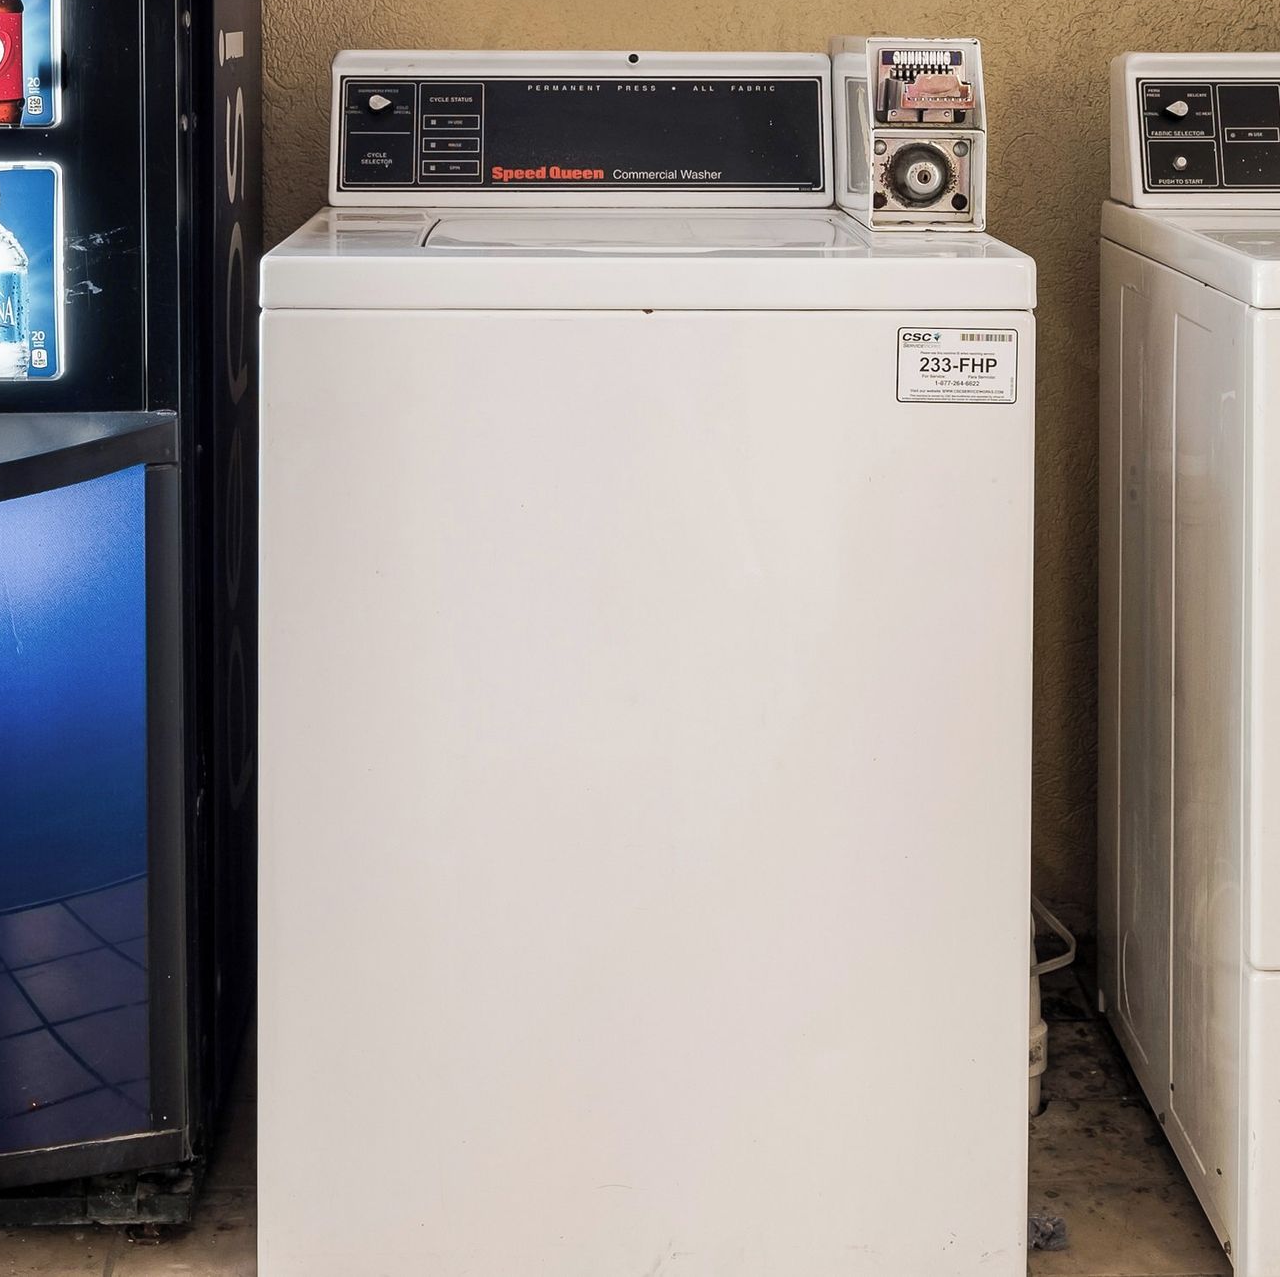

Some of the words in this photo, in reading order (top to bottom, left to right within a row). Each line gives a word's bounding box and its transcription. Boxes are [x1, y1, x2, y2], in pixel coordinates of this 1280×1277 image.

[27, 77, 40, 87] 20
[491, 165, 546, 181] Speed
[549, 165, 604, 179] Queen
[613, 169, 678, 180] Commercial
[680, 169, 721, 180] Washer
[32, 331, 45, 341] 20
[902, 333, 931, 341] CSC
[920, 357, 997, 372] 233-FHP
